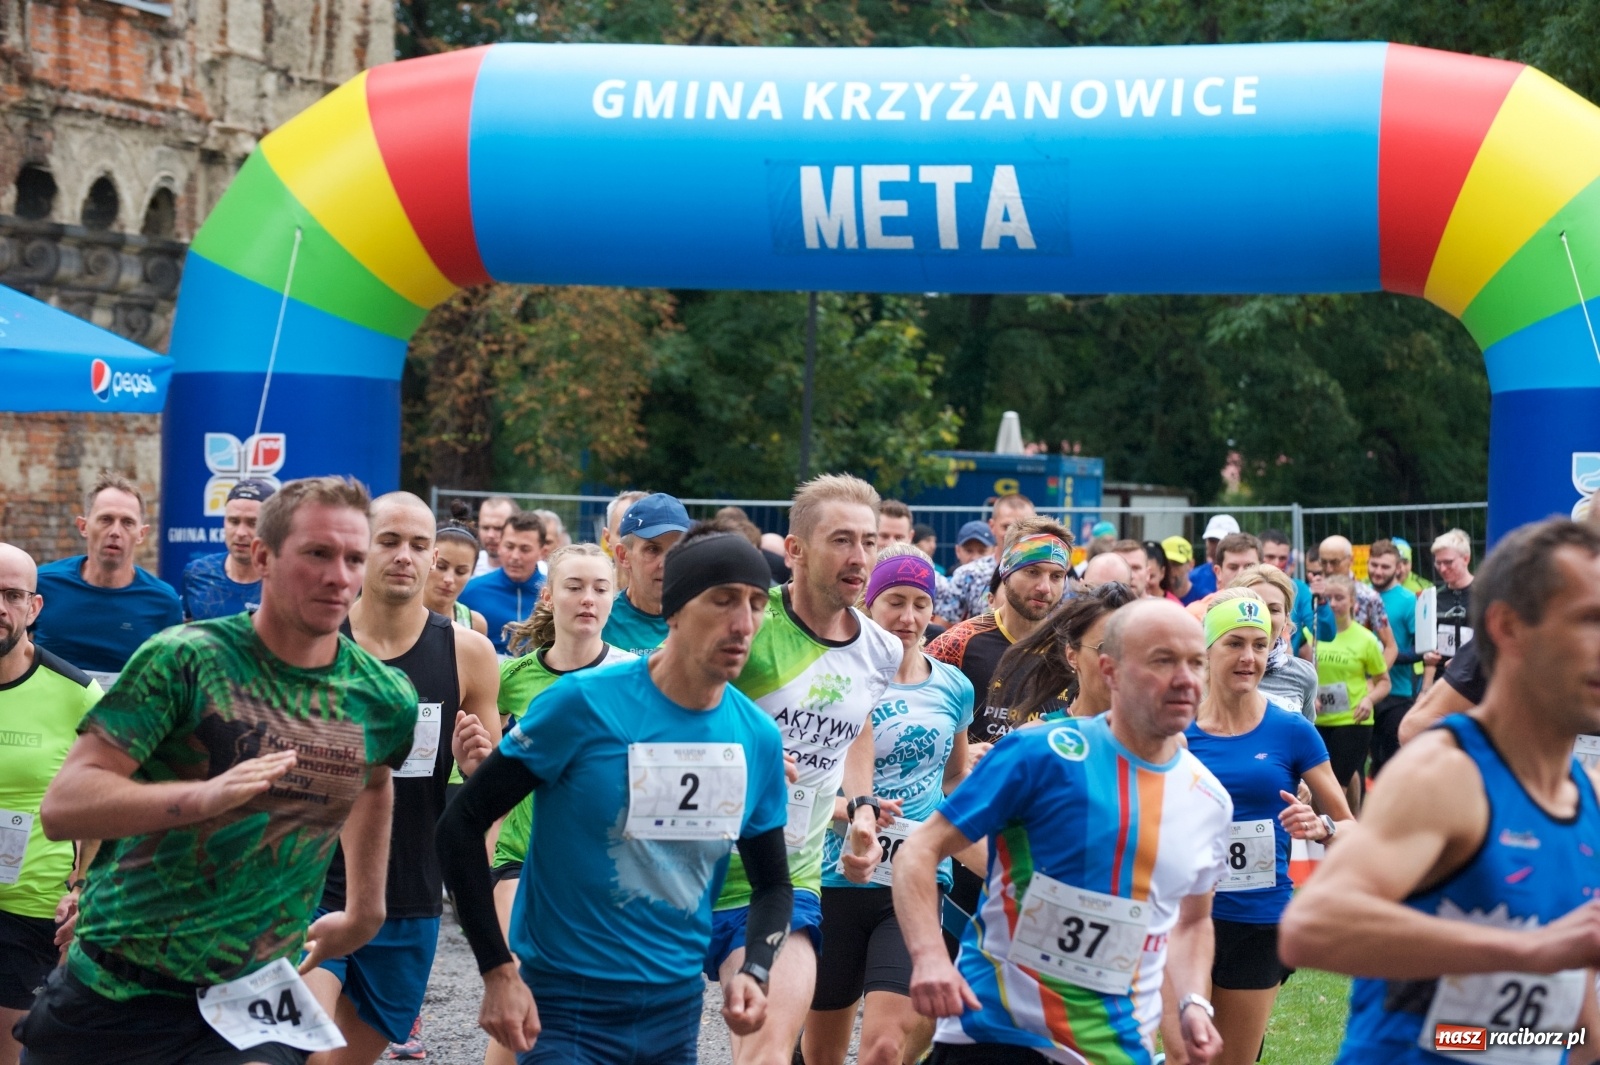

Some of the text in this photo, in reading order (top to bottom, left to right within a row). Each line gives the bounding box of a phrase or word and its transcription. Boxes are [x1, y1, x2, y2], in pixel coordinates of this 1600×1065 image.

[592, 73, 1260, 121] GMINA KRZYŻANOWICE
[799, 164, 1038, 250] META
[167, 527, 208, 543] GMINA
[678, 772, 700, 811] 2
[1226, 841, 1247, 871] 8
[1057, 915, 1110, 960] 37
[247, 987, 302, 1027] 94
[1489, 979, 1548, 1031] 26
